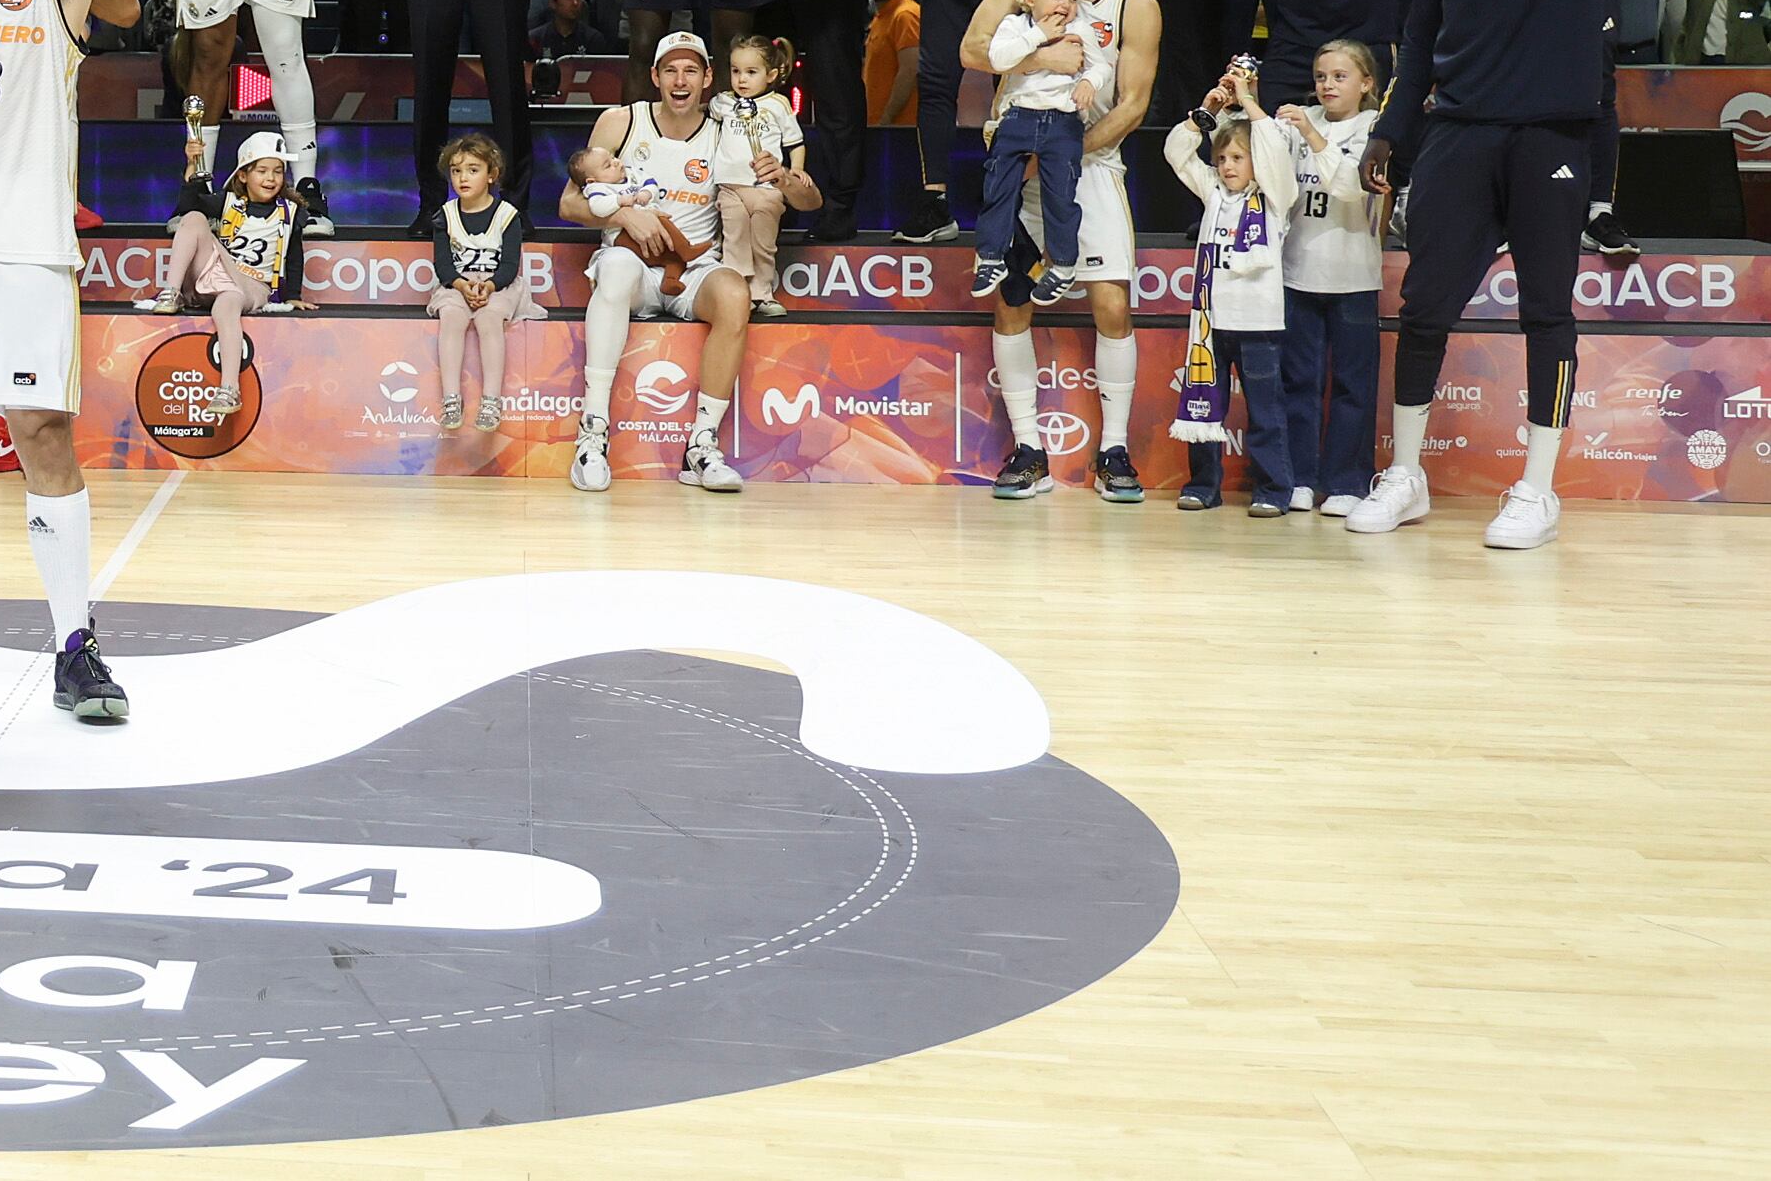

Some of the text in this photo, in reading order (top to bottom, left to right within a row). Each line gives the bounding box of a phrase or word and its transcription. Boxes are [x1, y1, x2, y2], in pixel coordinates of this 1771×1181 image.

[1303, 191, 1328, 218] 13
[228, 236, 268, 266] 23
[15, 375, 32, 385] acb
[171, 369, 204, 383] acb
[159, 382, 217, 407] Copa
[501, 387, 585, 417] málaga
[1626, 383, 1683, 404] renfe
[163, 402, 226, 426] del Rey
[361, 406, 441, 425] Andalucía
[835, 396, 932, 416] Movistar
[1447, 402, 1481, 411] seguros
[618, 421, 656, 431] COSTA
[659, 421, 682, 431] DEL
[639, 432, 686, 443] MÁLAGA
[1584, 448, 1657, 461] Halcón viajes
[1688, 446, 1726, 455] AMAYU
